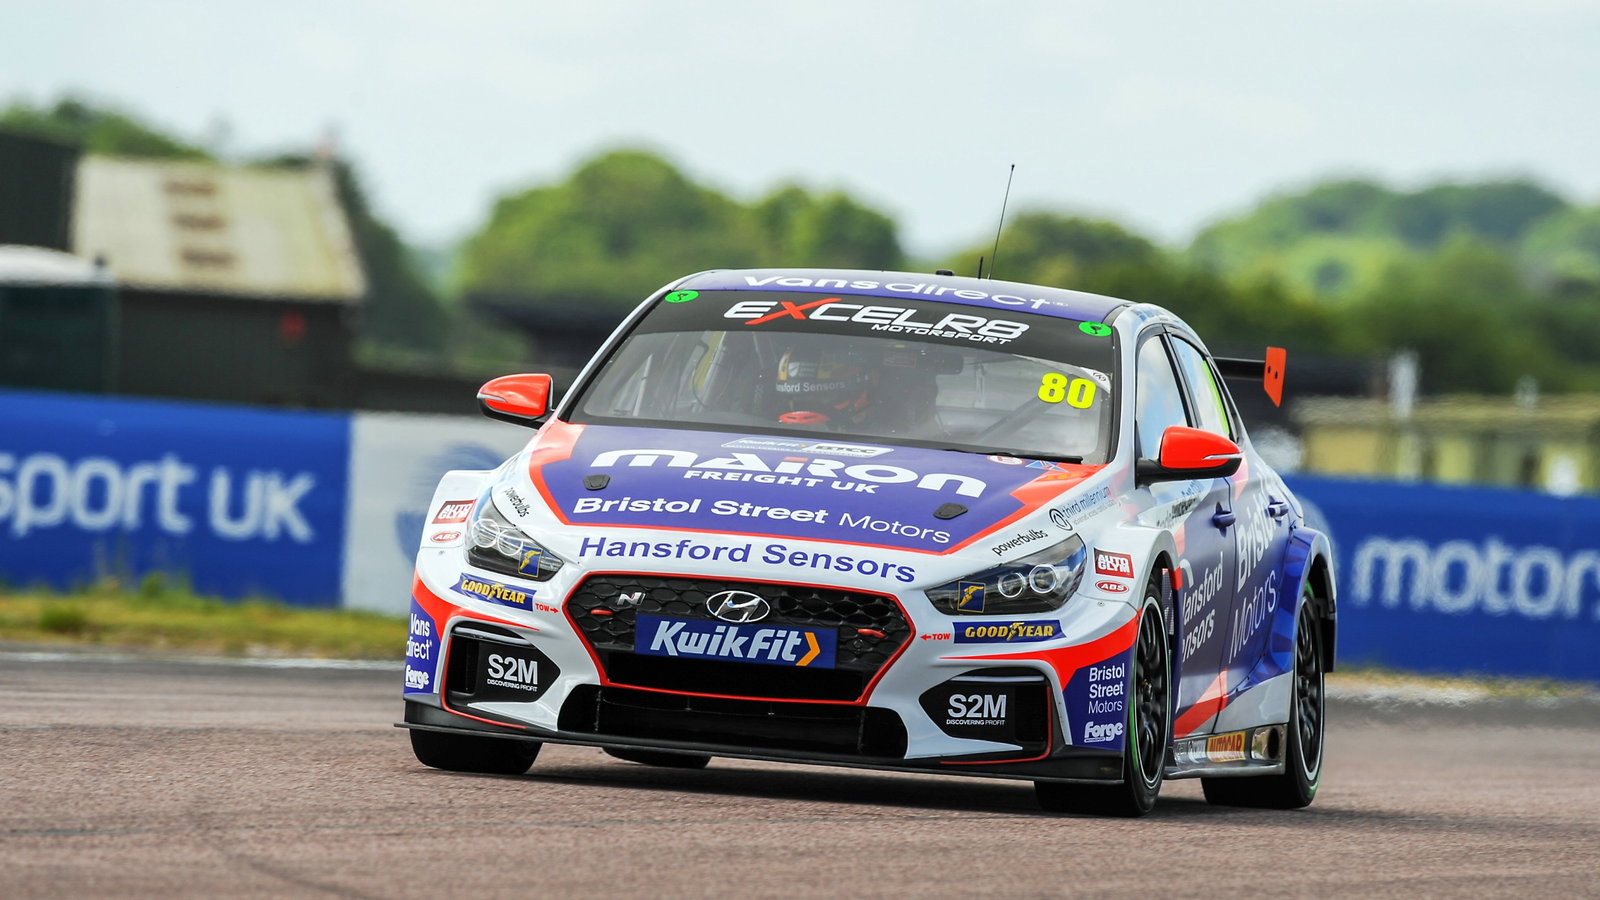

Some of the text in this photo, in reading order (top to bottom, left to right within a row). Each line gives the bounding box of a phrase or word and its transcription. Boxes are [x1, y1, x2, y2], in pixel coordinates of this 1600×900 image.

[723, 298, 1030, 339] EXCELR8
[871, 324, 1012, 345] MOTORSPORT
[803, 381, 846, 392] Sensors
[1038, 372, 1097, 409] 80
[683, 470, 880, 494] FREIGHT UK
[209, 466, 315, 542] UK
[1062, 500, 1082, 519] third
[573, 497, 952, 544] Bristol Street Motors
[435, 532, 458, 541] ABS
[992, 529, 1049, 557] powerbulbs
[578, 537, 916, 583] Hansford Sensors
[1097, 553, 1129, 566] AUTO
[1097, 561, 1130, 574] GLYM
[1100, 582, 1125, 591] ABS
[1182, 551, 1223, 626] ansford
[535, 602, 550, 612] TOW
[1229, 570, 1277, 664] Motors
[410, 613, 430, 637] Vans
[932, 633, 950, 641] TOW
[487, 653, 538, 685] S2M
[1089, 663, 1125, 682] Bristol
[487, 678, 538, 692] DISCOVERING PROFIT
[1089, 681, 1124, 699] Street
[947, 694, 1006, 718] S2M
[1088, 700, 1123, 714] Motors
[946, 718, 985, 726] DISCOVERING
